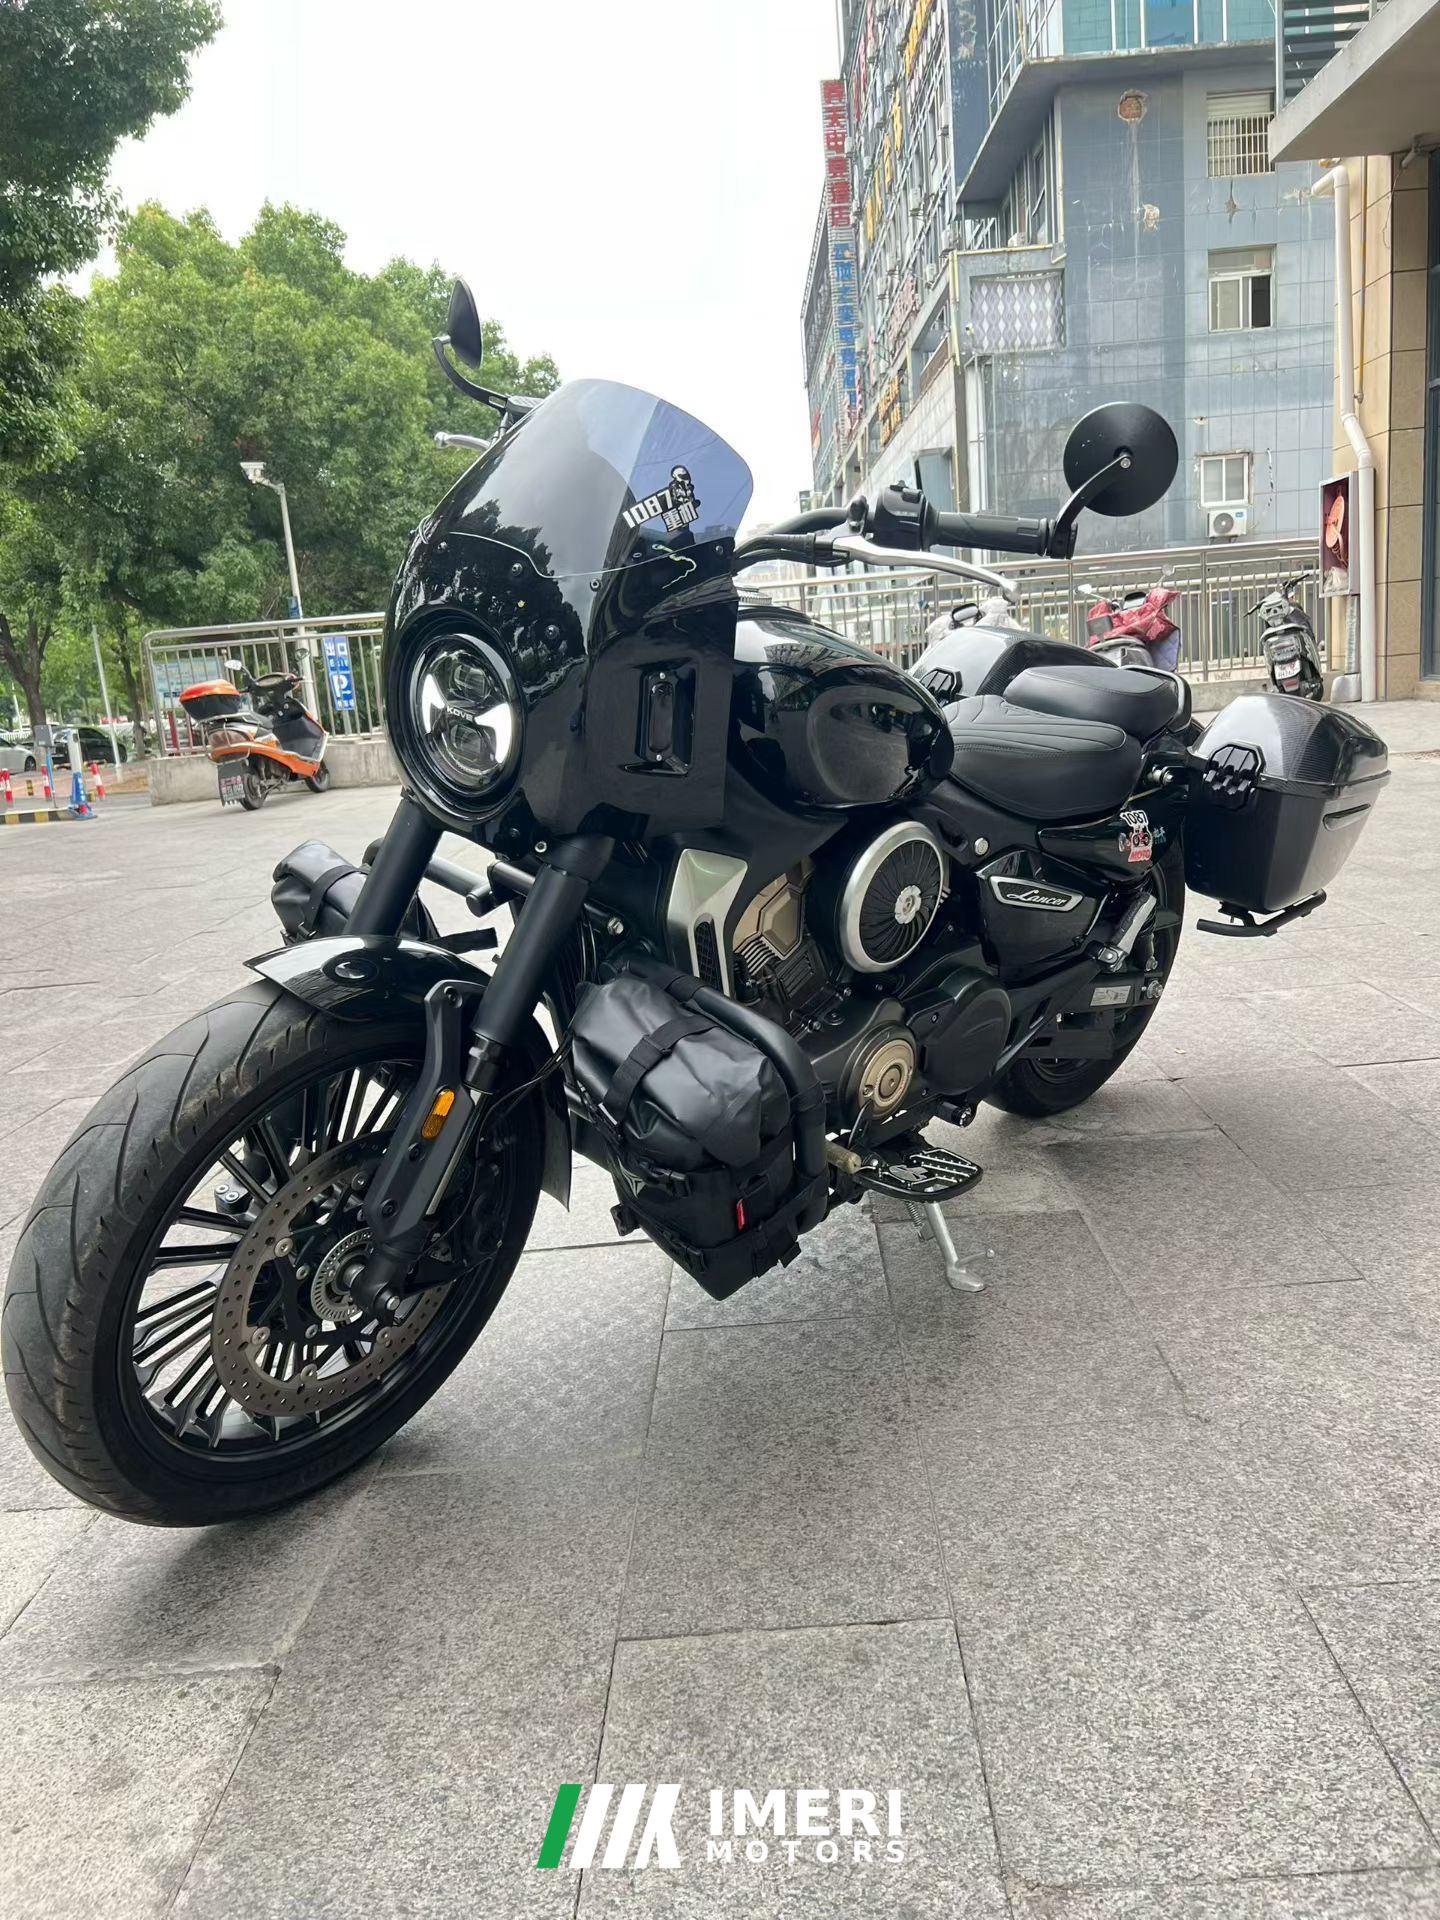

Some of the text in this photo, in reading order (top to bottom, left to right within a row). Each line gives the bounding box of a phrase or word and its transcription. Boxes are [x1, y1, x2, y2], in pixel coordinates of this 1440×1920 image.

[622, 488, 673, 529] 1087
[661, 501, 698, 532] 重机
[332, 674, 349, 698] P
[446, 705, 474, 722] KOVE
[1122, 811, 1148, 825] 1087
[1129, 849, 1151, 860] MOTO
[1006, 889, 1068, 906] Lancer
